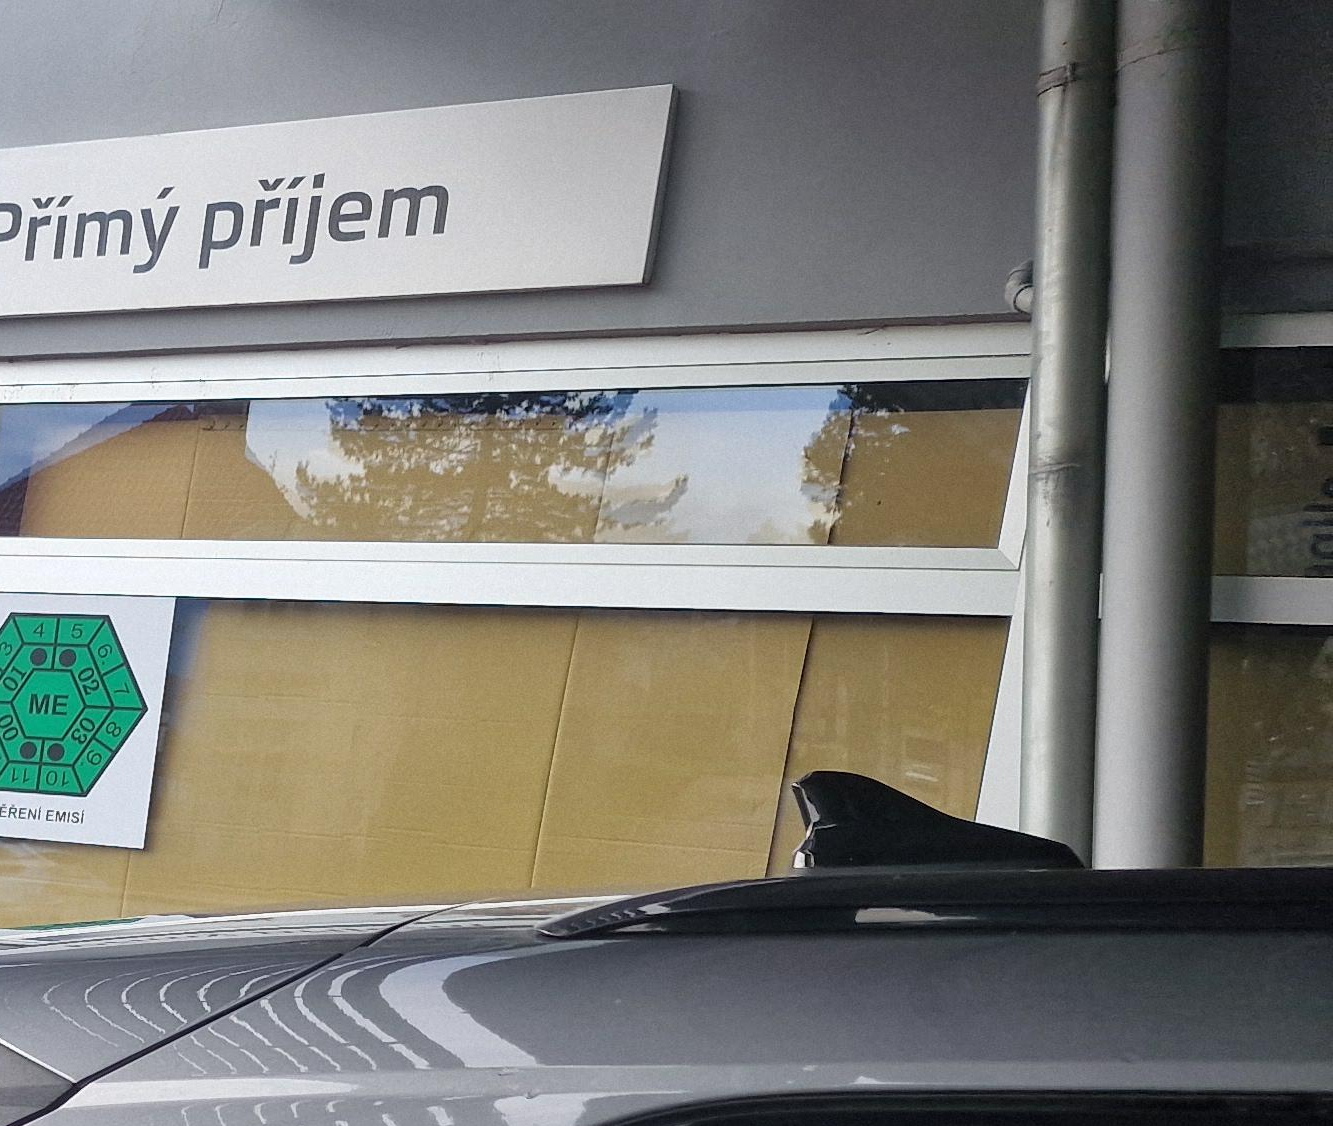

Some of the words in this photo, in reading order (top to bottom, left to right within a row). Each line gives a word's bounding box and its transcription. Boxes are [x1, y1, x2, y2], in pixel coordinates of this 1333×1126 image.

[198, 173, 449, 269] příjem
[33, 622, 46, 638] 4
[70, 623, 84, 639] 5
[2, 666, 27, 692] 01
[77, 667, 101, 696] 02
[113, 682, 130, 696] 7
[28, 693, 69, 716] ME
[70, 717, 97, 744] 03
[105, 721, 122, 738] 8
[45, 771, 69, 787] 10
[45, 808, 85, 824] EMISÍ
